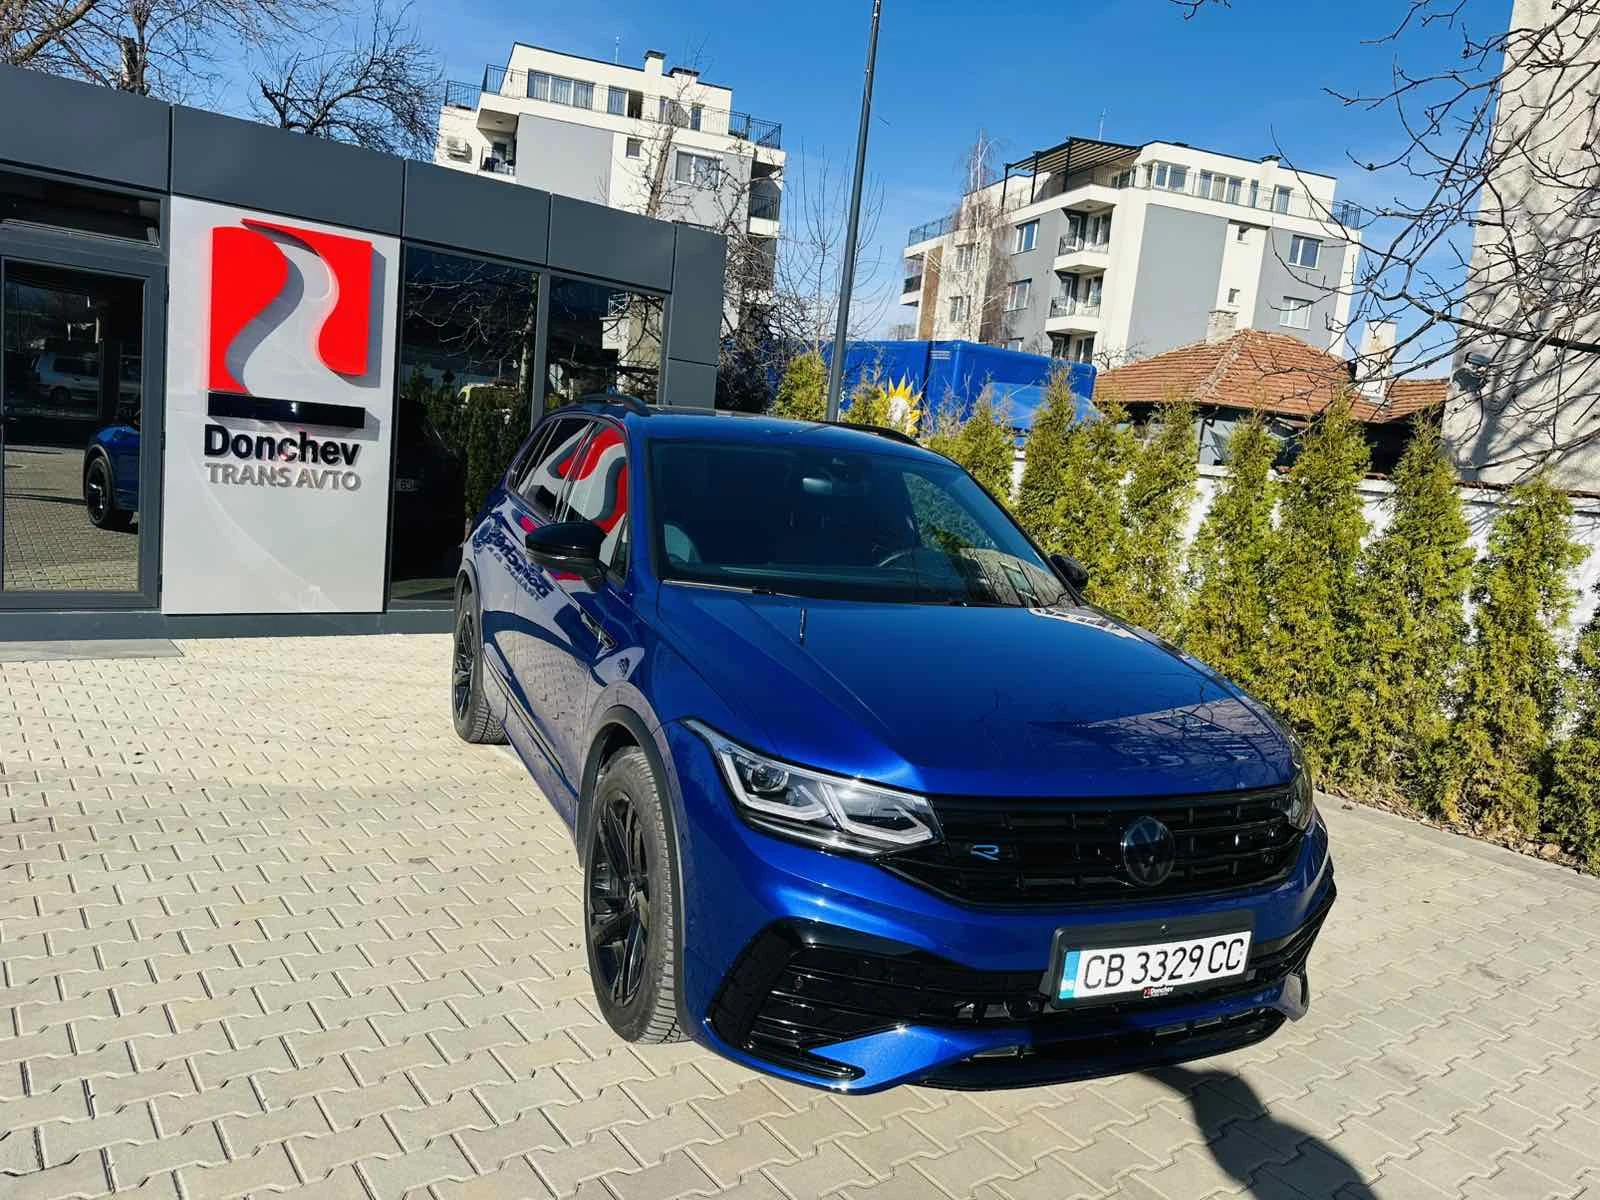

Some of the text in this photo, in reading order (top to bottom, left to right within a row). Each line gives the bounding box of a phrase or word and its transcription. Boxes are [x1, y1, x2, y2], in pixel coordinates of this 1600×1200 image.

[204, 423, 360, 466] Donchev
[205, 462, 362, 491] TRANS AVTO
[1083, 938, 1244, 990] CB 3329 CC
